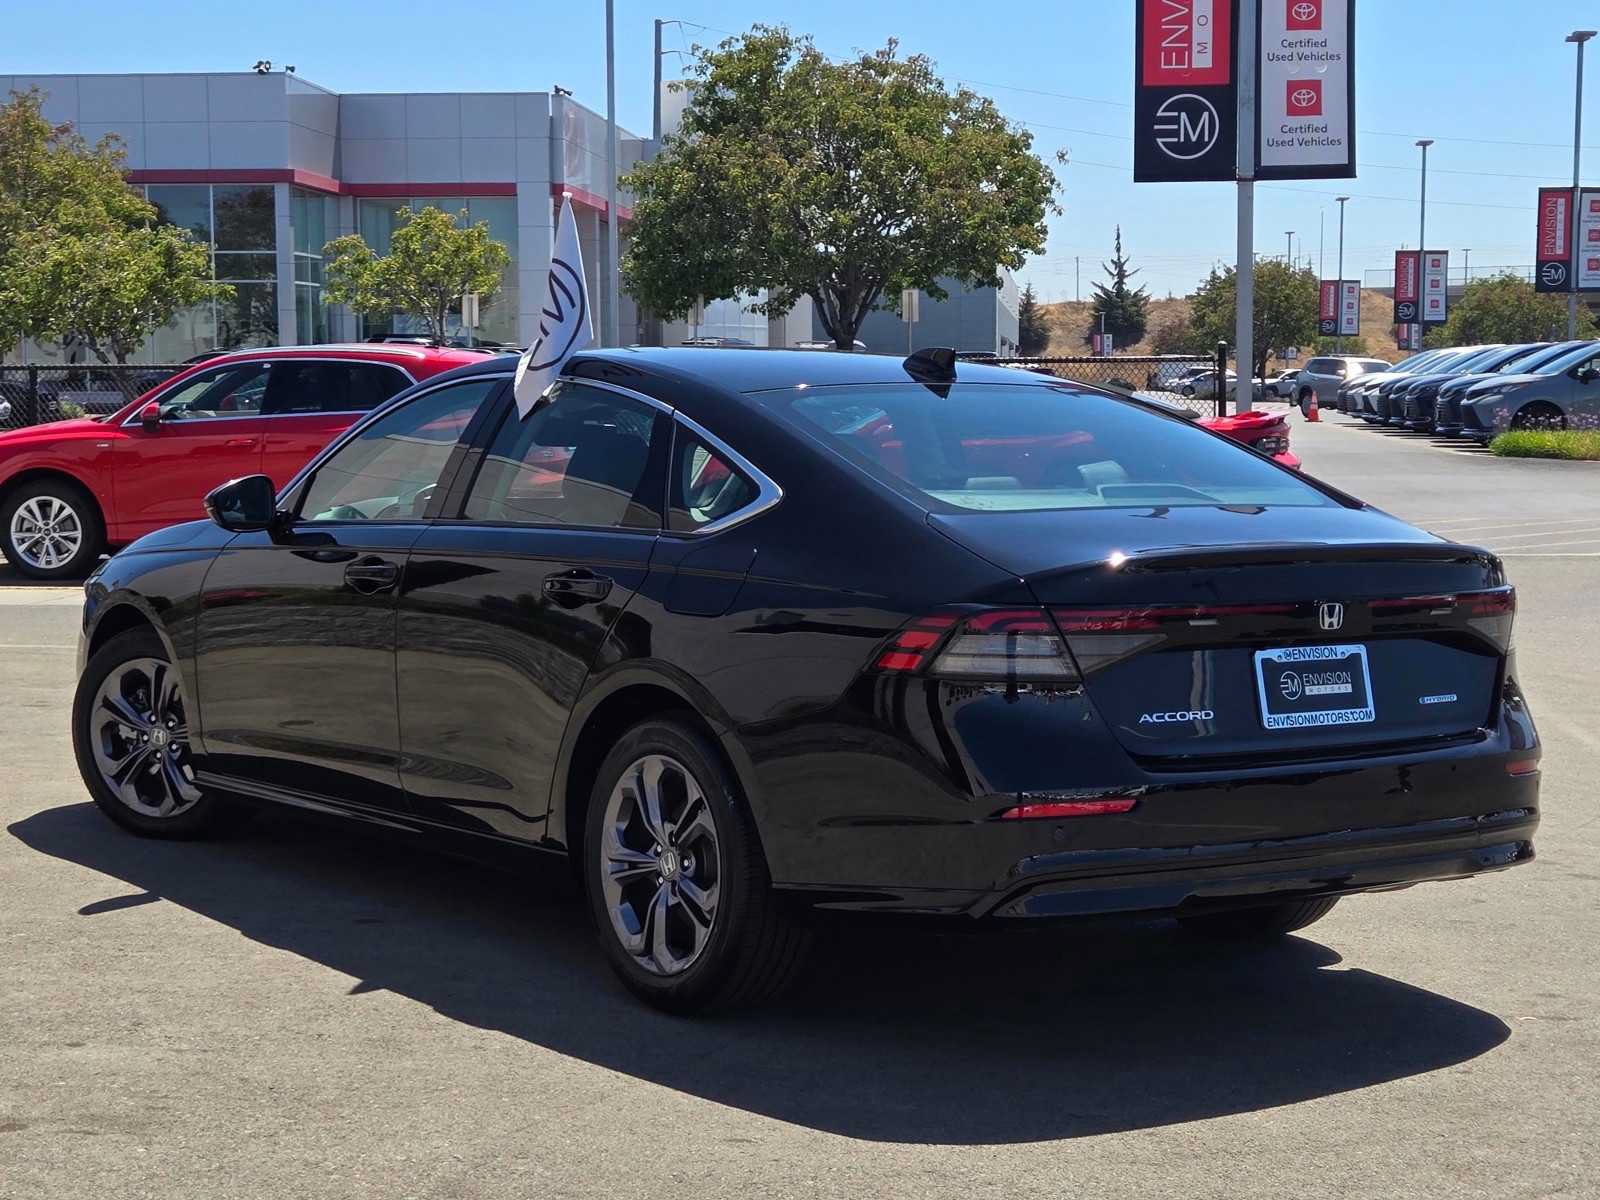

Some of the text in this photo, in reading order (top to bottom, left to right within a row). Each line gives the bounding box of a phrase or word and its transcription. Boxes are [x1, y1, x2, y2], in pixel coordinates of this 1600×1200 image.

[1280, 38, 1328, 49] Certified
[1266, 51, 1342, 62] Used Vehicles
[1280, 123, 1328, 134] Certified
[1266, 136, 1342, 147] Used Vehicles
[1544, 197, 1557, 256] ENVISION
[1303, 671, 1351, 686] ENVISION
[1139, 710, 1214, 723] ACCORD
[1267, 710, 1373, 728] ENVISIONMOTORS.COM
